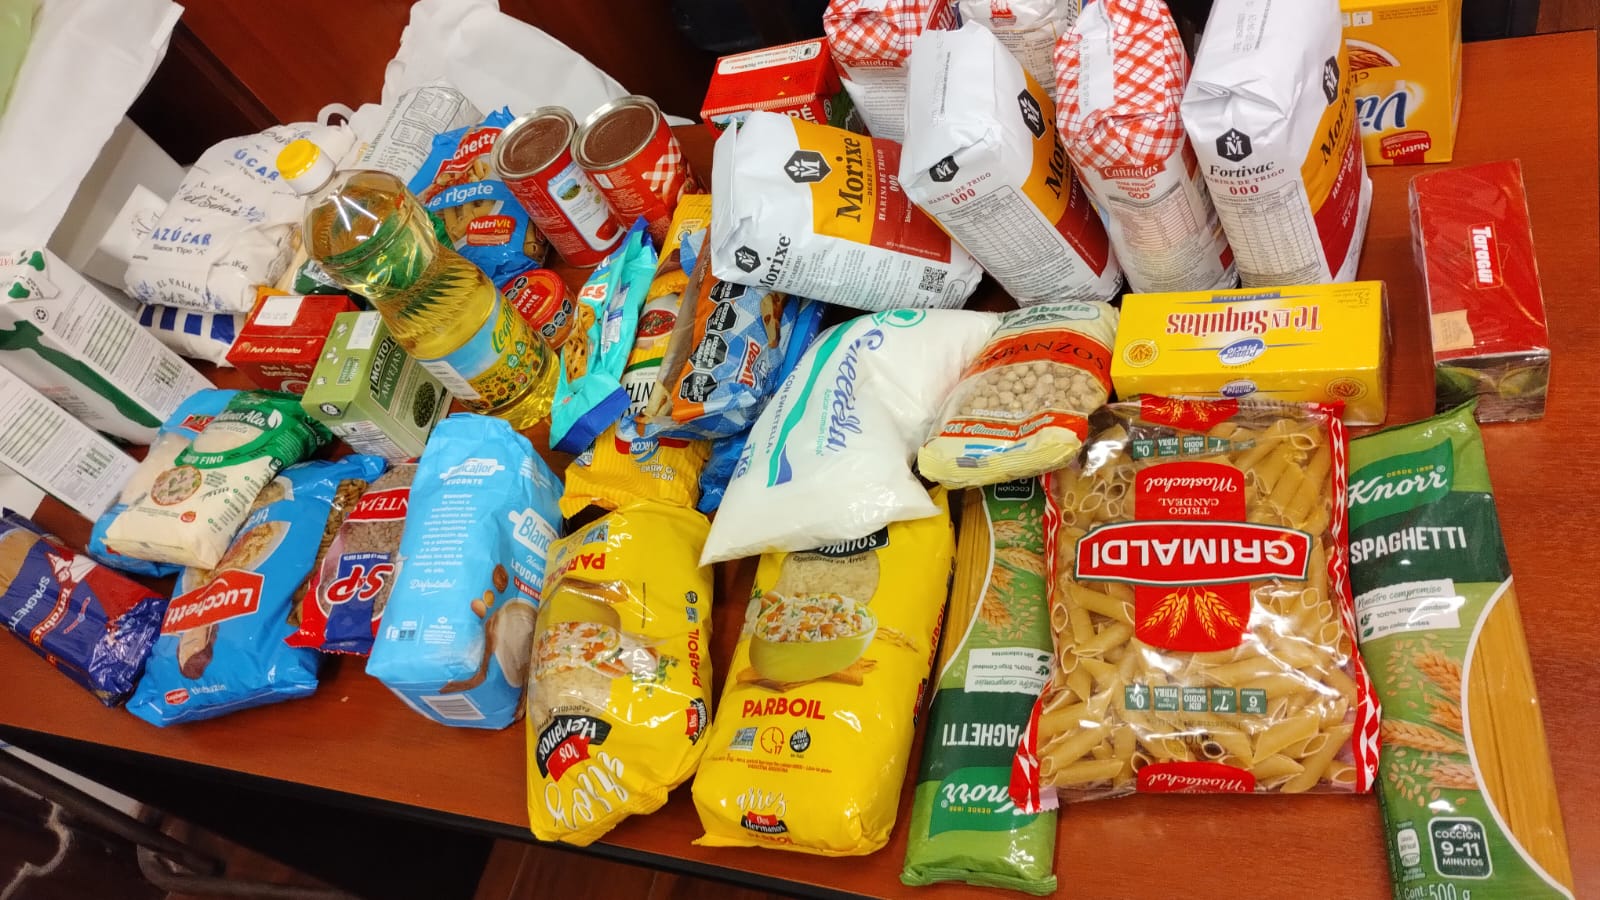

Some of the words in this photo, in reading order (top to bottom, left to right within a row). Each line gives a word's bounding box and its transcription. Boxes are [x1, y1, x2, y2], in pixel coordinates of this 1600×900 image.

[1387, 141, 1430, 158] NutriVit
[876, 148, 887, 172] TRIGO
[880, 171, 888, 184] DE
[1104, 163, 1158, 179] Cañuelas
[1209, 161, 1275, 178] Fortivac
[1254, 168, 1285, 182] TRIGO
[835, 137, 865, 223] Morixe
[956, 185, 967, 194] DE
[966, 172, 992, 188] TRIGO
[445, 182, 495, 204] rigate
[951, 188, 977, 205] 000
[1229, 184, 1260, 196] 000
[877, 186, 888, 221] HARINA
[469, 219, 512, 232] NutriVit
[151, 226, 214, 247] AZÚCAR
[1471, 225, 1494, 284] Taragüi
[1166, 307, 1270, 338] Saquitos
[381, 349, 402, 401] ARVEJAS
[784, 373, 797, 395] CON
[242, 409, 268, 428] Ala
[962, 421, 1016, 438] Alimentos
[629, 439, 656, 453] ARCOR
[1157, 437, 1179, 447] FIBRA
[1136, 444, 1151, 457] 0%
[199, 455, 224, 465] FINO
[1386, 468, 1413, 479] DESDE
[1143, 475, 1238, 493] Mostachol
[1348, 471, 1447, 509] Knorr
[1157, 497, 1220, 507] CANDEAL
[1169, 506, 1210, 516] TRIGO
[1091, 536, 1296, 569] GRIMALDI
[1350, 526, 1468, 565] SPAGHETTI
[1388, 585, 1443, 601] compromiso
[165, 586, 254, 627] Lucchetti
[687, 629, 703, 689] PARBOIL
[1154, 688, 1178, 698] FIBRA
[1183, 694, 1207, 702] SODIO
[741, 697, 826, 720] PARBOIL
[1129, 694, 1145, 709] 0%
[1248, 696, 1258, 708] 6
[773, 744, 784, 756] 17
[1146, 772, 1247, 793] Mostachol
[967, 805, 992, 815] DESDE
[745, 820, 786, 833] Hermanos
[756, 815, 770, 826] Dos
[1435, 828, 1481, 840] COCCIÓN
[1440, 842, 1481, 858] 9-11
[1442, 857, 1485, 867] MINUTOS
[1429, 883, 1457, 900] 500
